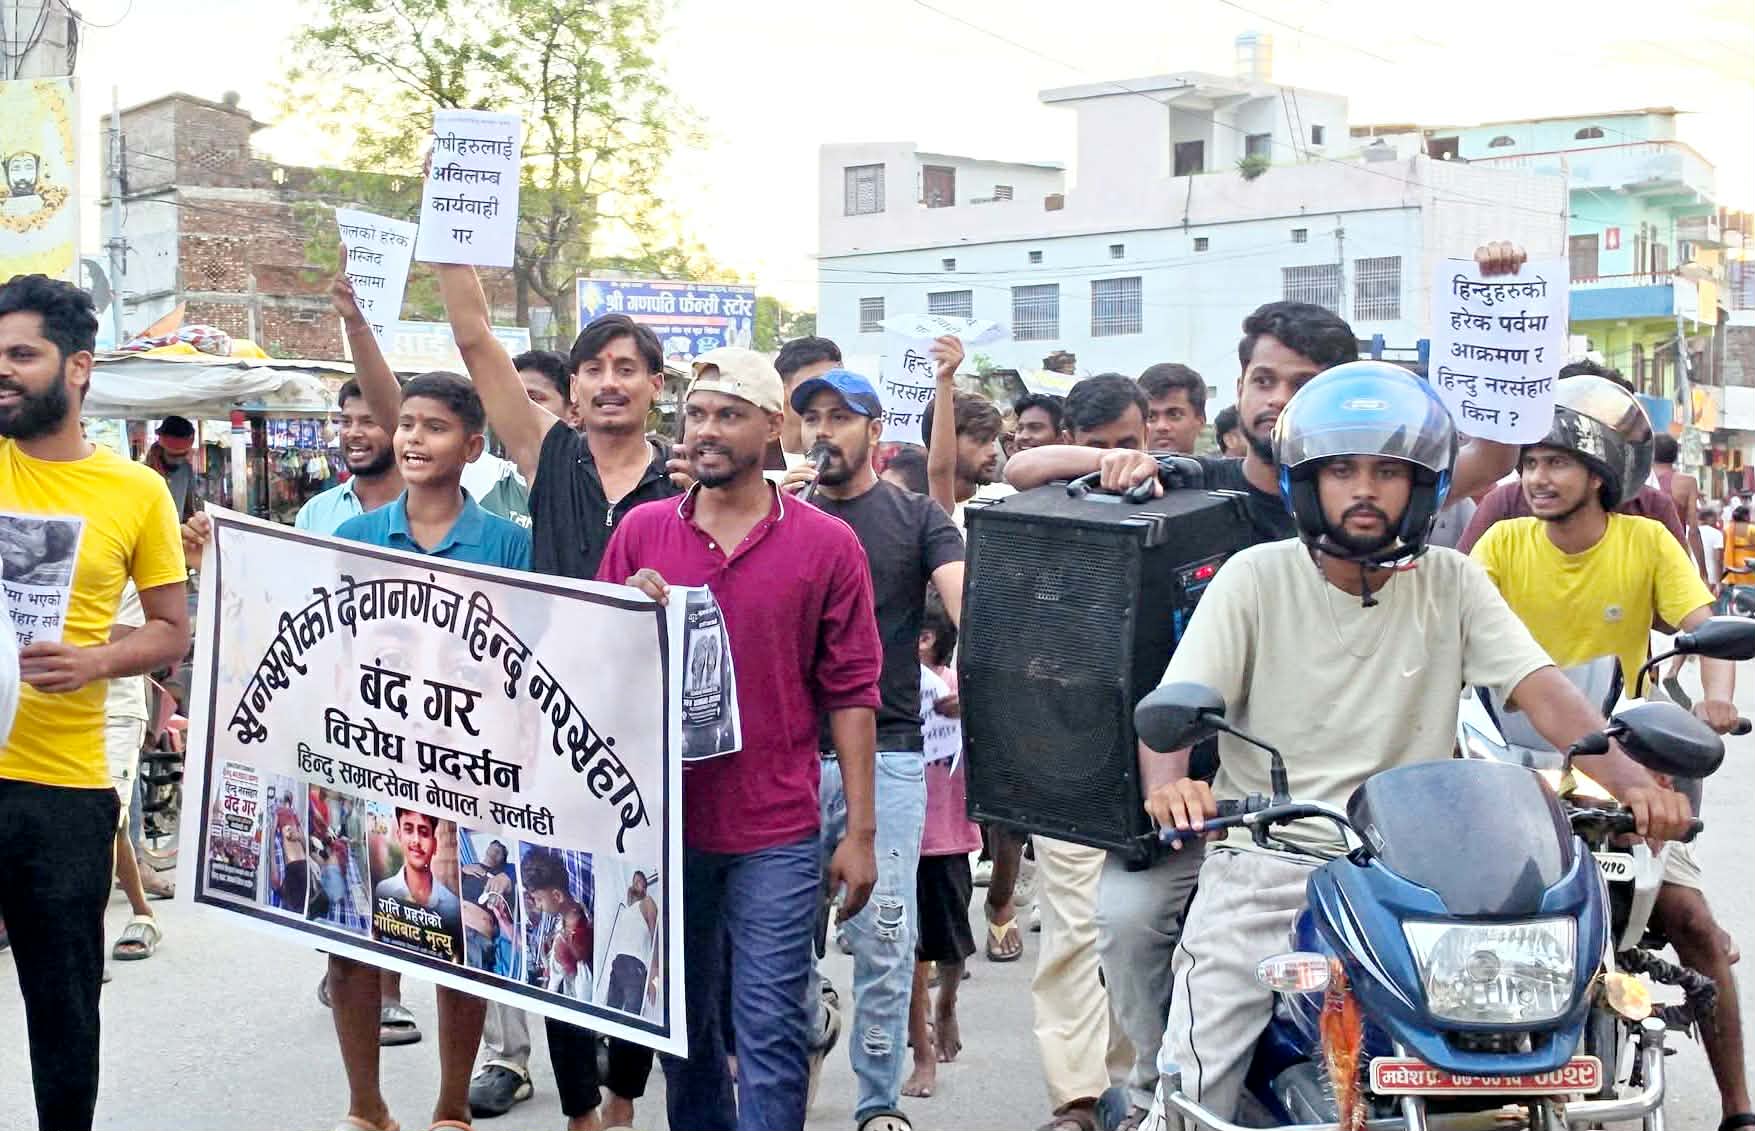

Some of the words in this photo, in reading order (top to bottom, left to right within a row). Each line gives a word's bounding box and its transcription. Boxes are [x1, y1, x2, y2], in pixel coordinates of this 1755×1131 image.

[432, 131, 515, 160] ोषीहरुलाई
[432, 162, 502, 185] अविलम्ब
[431, 193, 499, 219] कार्यवाही
[452, 228, 474, 245] गर
[606, 289, 624, 312] श्री
[722, 294, 755, 317] स्टोर
[1452, 273, 1548, 307] हिन्दुहरुको
[1450, 306, 1493, 332] हरेक
[1498, 310, 1549, 333] पर्वमा
[903, 348, 934, 378] हिन्दु
[1450, 342, 1530, 365] आक्रमण
[1534, 346, 1545, 363] र
[1438, 366, 1479, 398] हिन्दु
[1484, 376, 1552, 398] नरसंहार
[1461, 399, 1501, 425] किन
[1509, 411, 1520, 427] ?
[360, 657, 411, 720] बंद
[423, 679, 482, 737] गर
[335, 574, 464, 638] देवानगंज
[462, 590, 533, 699] हिन्दु
[529, 660, 650, 854] नरसंहार
[324, 707, 406, 764] विरोध
[416, 740, 523, 794] प्रदर्सन
[297, 742, 336, 784] हिन्दु
[339, 759, 420, 802] सम्राटसेना
[489, 800, 555, 836] सर्लाही
